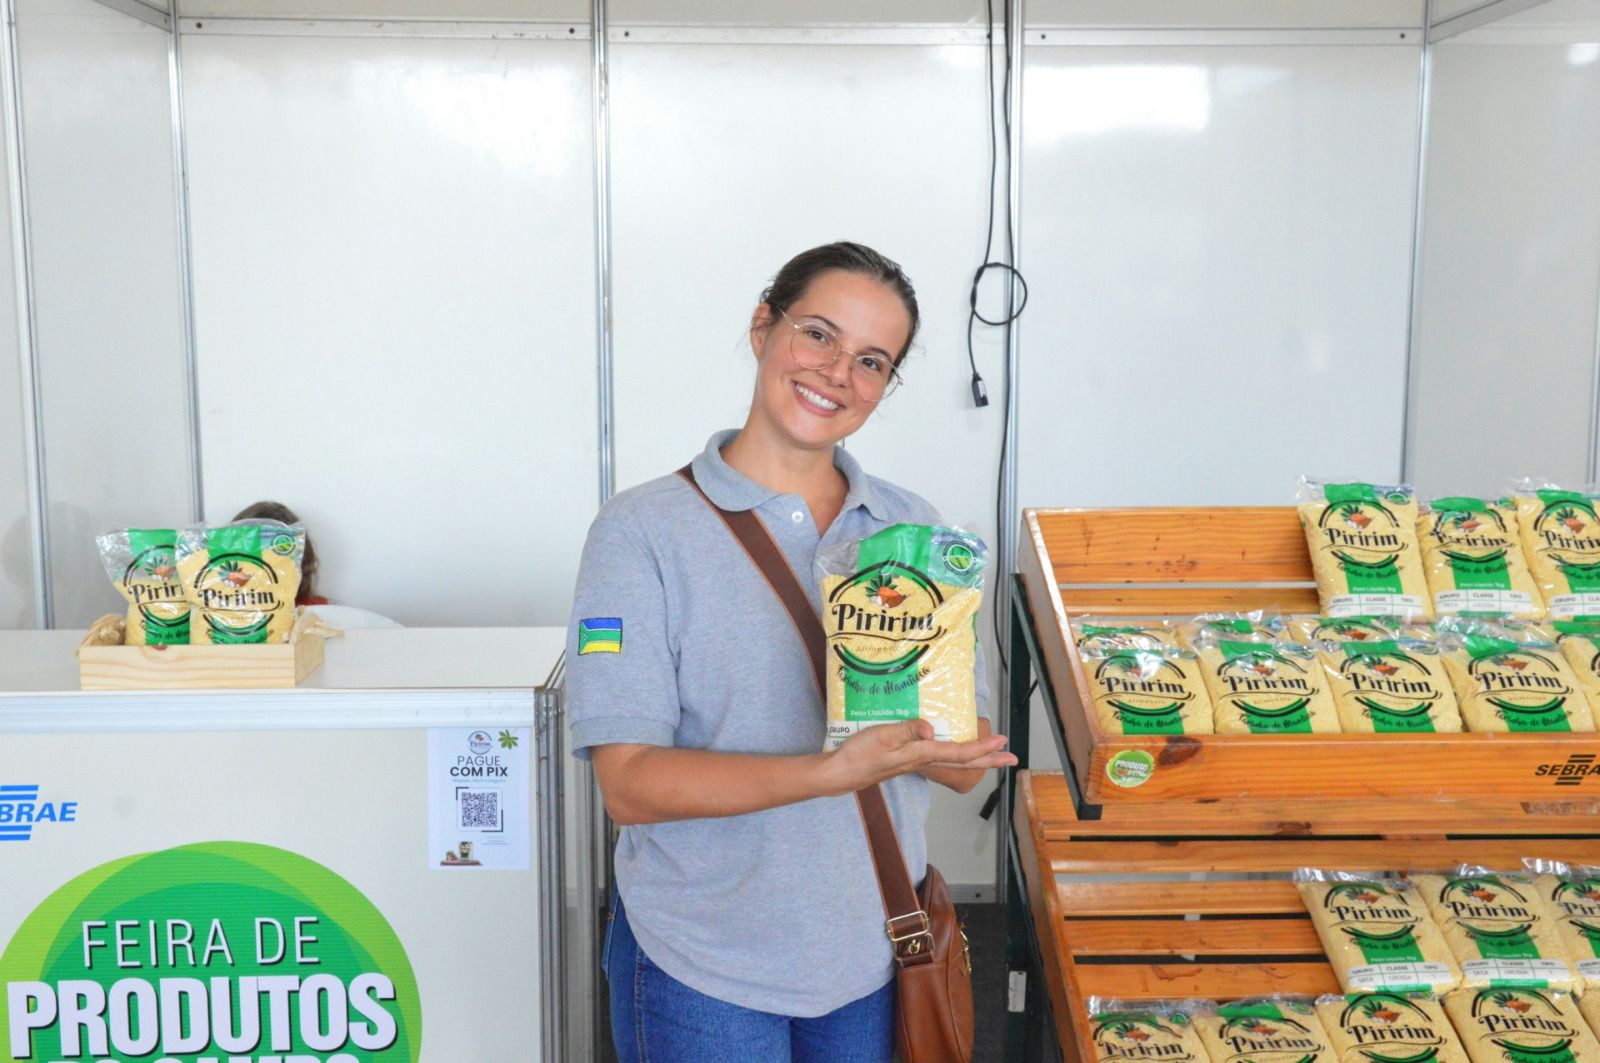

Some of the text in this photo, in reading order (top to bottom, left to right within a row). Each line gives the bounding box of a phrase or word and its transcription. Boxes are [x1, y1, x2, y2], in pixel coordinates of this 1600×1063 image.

[1323, 528, 1398, 546] Piririm
[197, 588, 275, 608] Piririm
[832, 603, 933, 632] Piririm
[1099, 677, 1184, 693] Piririm
[1223, 676, 1308, 691] Piririm
[1346, 672, 1432, 693] Piririm
[1475, 671, 1562, 690] Piririm
[457, 755, 501, 766] PAGUE
[450, 766, 508, 777] COM PIX
[0, 802, 78, 823] BRAE
[1330, 905, 1411, 920] Piririm
[1446, 901, 1529, 917] Piririm
[82, 916, 321, 969] FEIRA DE
[7, 972, 398, 1059] PRODUTOS
[1478, 1014, 1568, 1032] Piririm
[1346, 1020, 1435, 1043] Piririm
[1098, 1042, 1184, 1057] Piririm
[1226, 1036, 1312, 1053] Piririm
